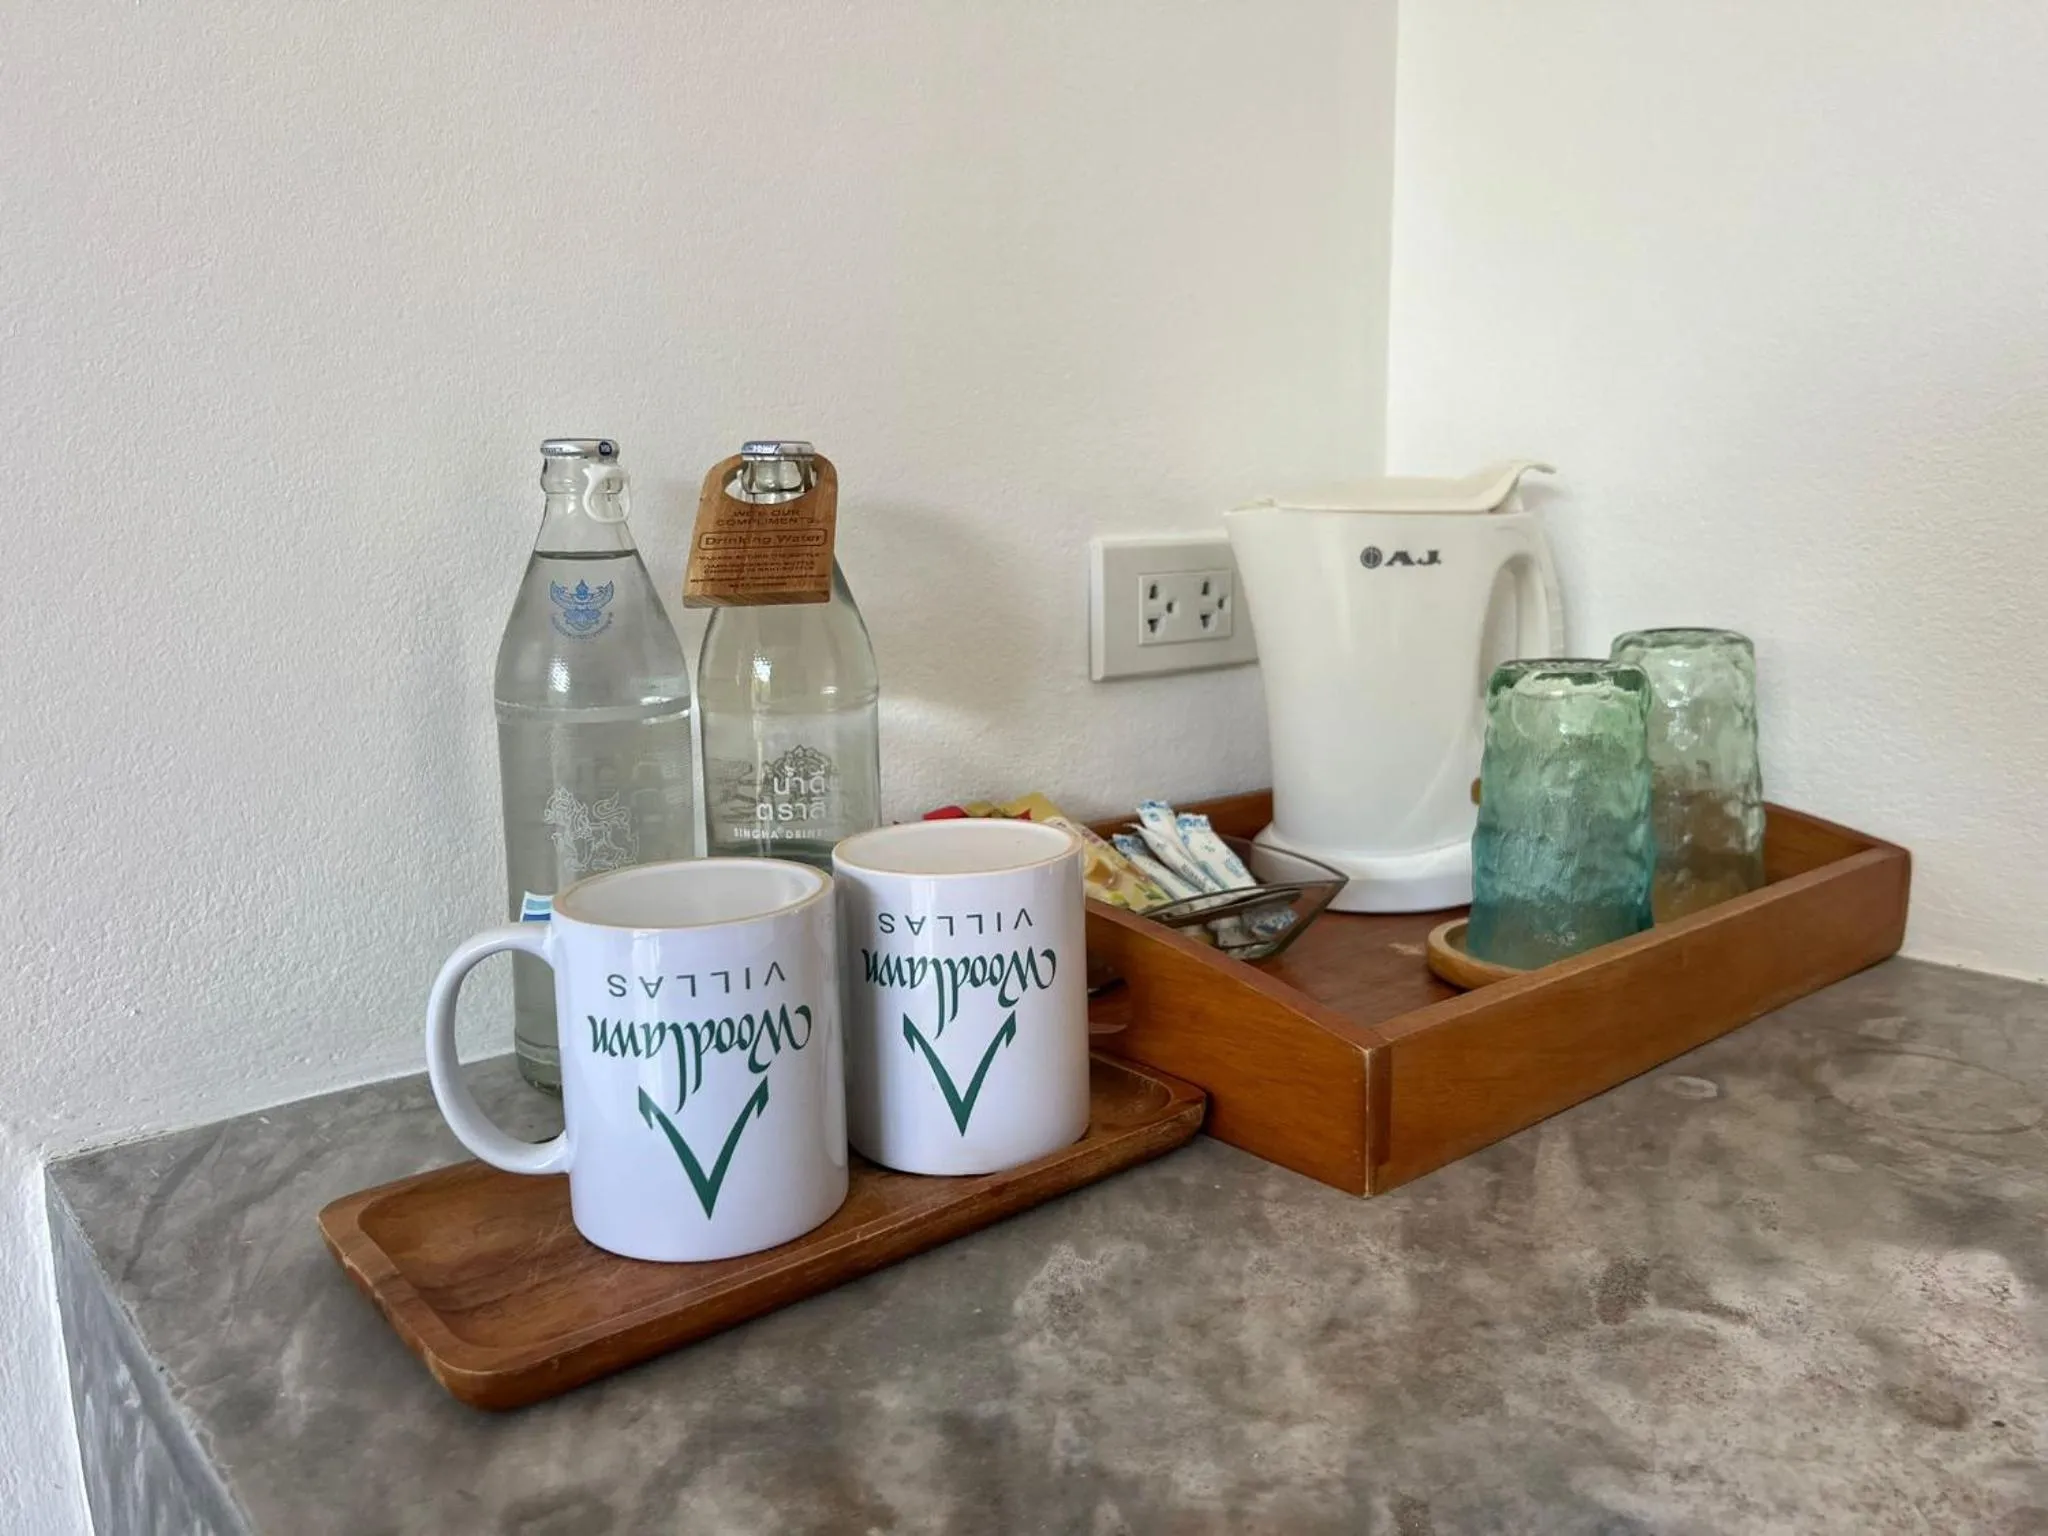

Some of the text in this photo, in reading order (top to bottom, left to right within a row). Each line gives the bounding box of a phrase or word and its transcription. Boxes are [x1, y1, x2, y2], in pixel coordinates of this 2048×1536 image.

[704, 533, 821, 546] Drinking Water
[733, 827, 779, 839] SINGHA
[878, 907, 1034, 937] VILLAS
[606, 961, 787, 1000] VILLAS
[860, 945, 1057, 1041] Woodlawn
[586, 1003, 812, 1115] Woodlawn
